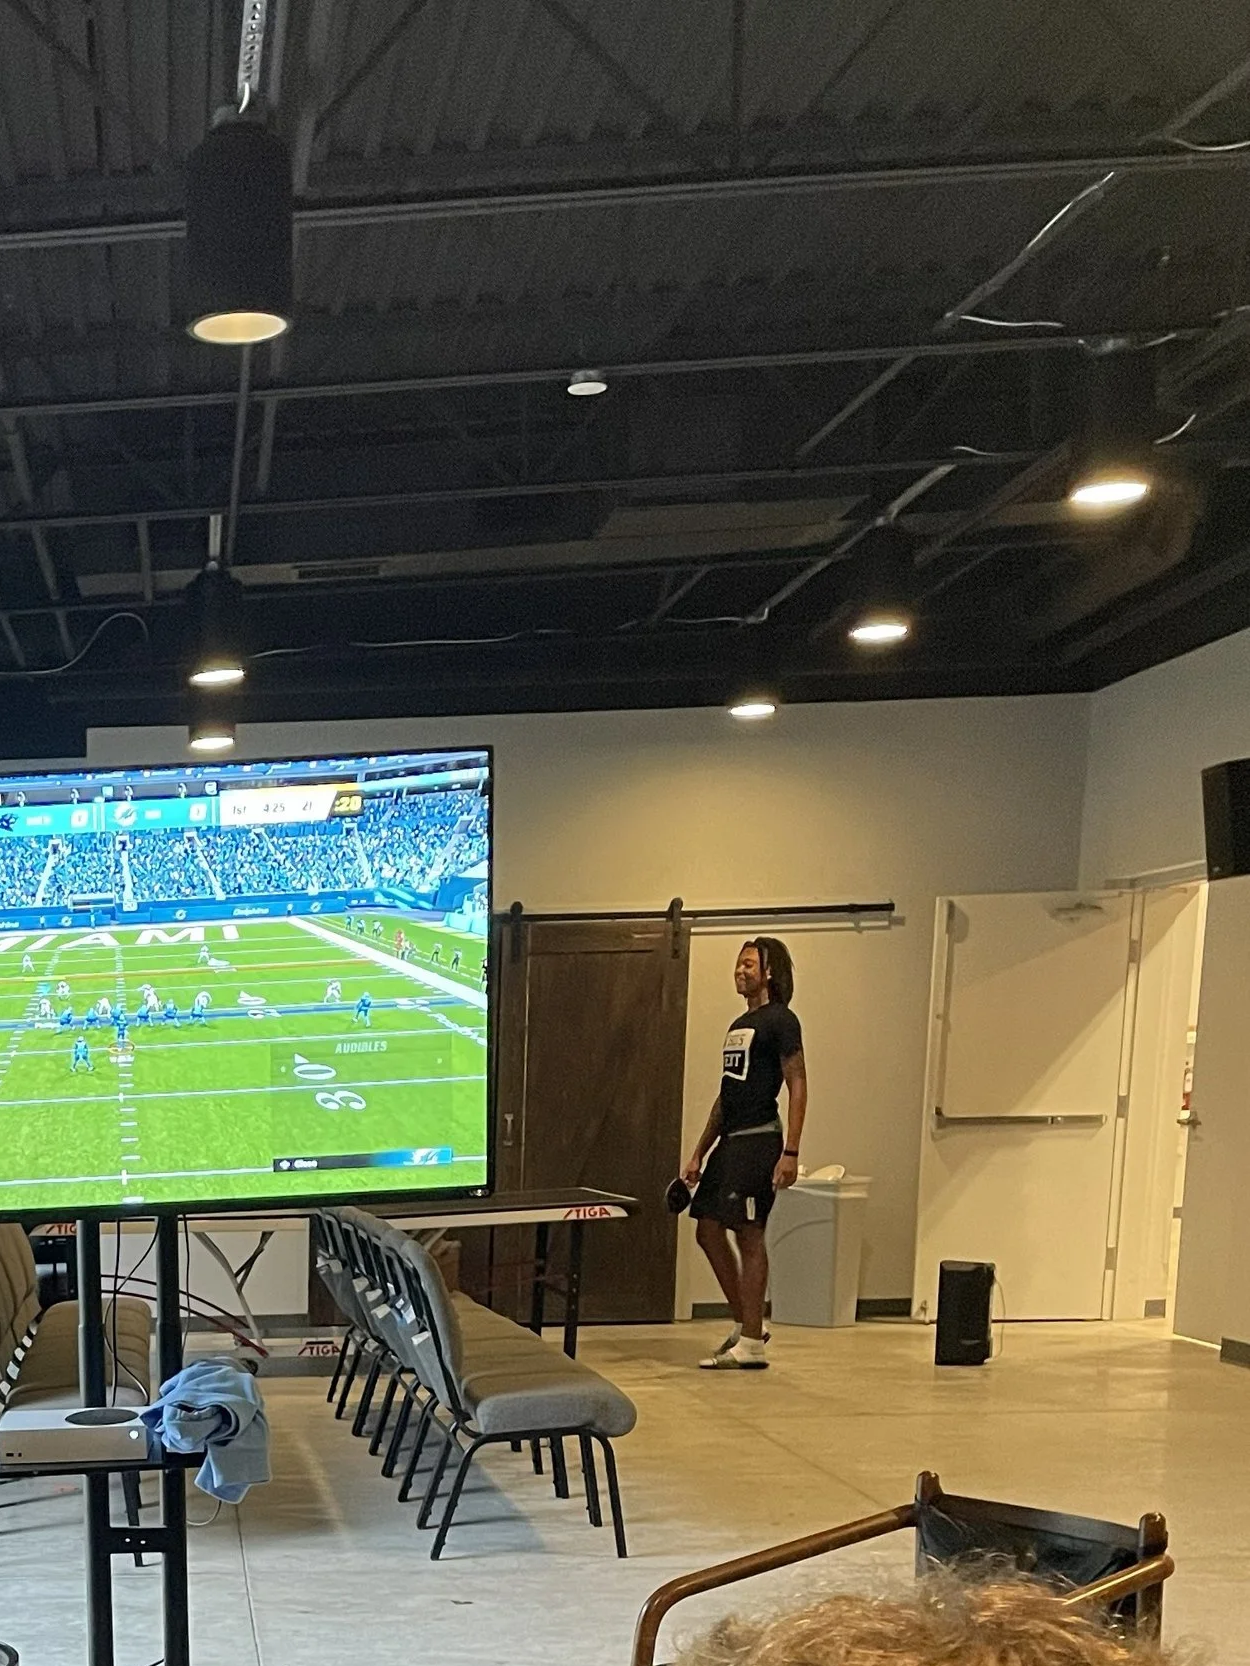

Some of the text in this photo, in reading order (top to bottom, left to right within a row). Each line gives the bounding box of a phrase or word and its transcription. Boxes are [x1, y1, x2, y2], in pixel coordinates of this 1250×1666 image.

[334, 1040, 388, 1054] AUDIBLES
[563, 1207, 611, 1220] STIGA
[45, 1224, 77, 1235] STIG
